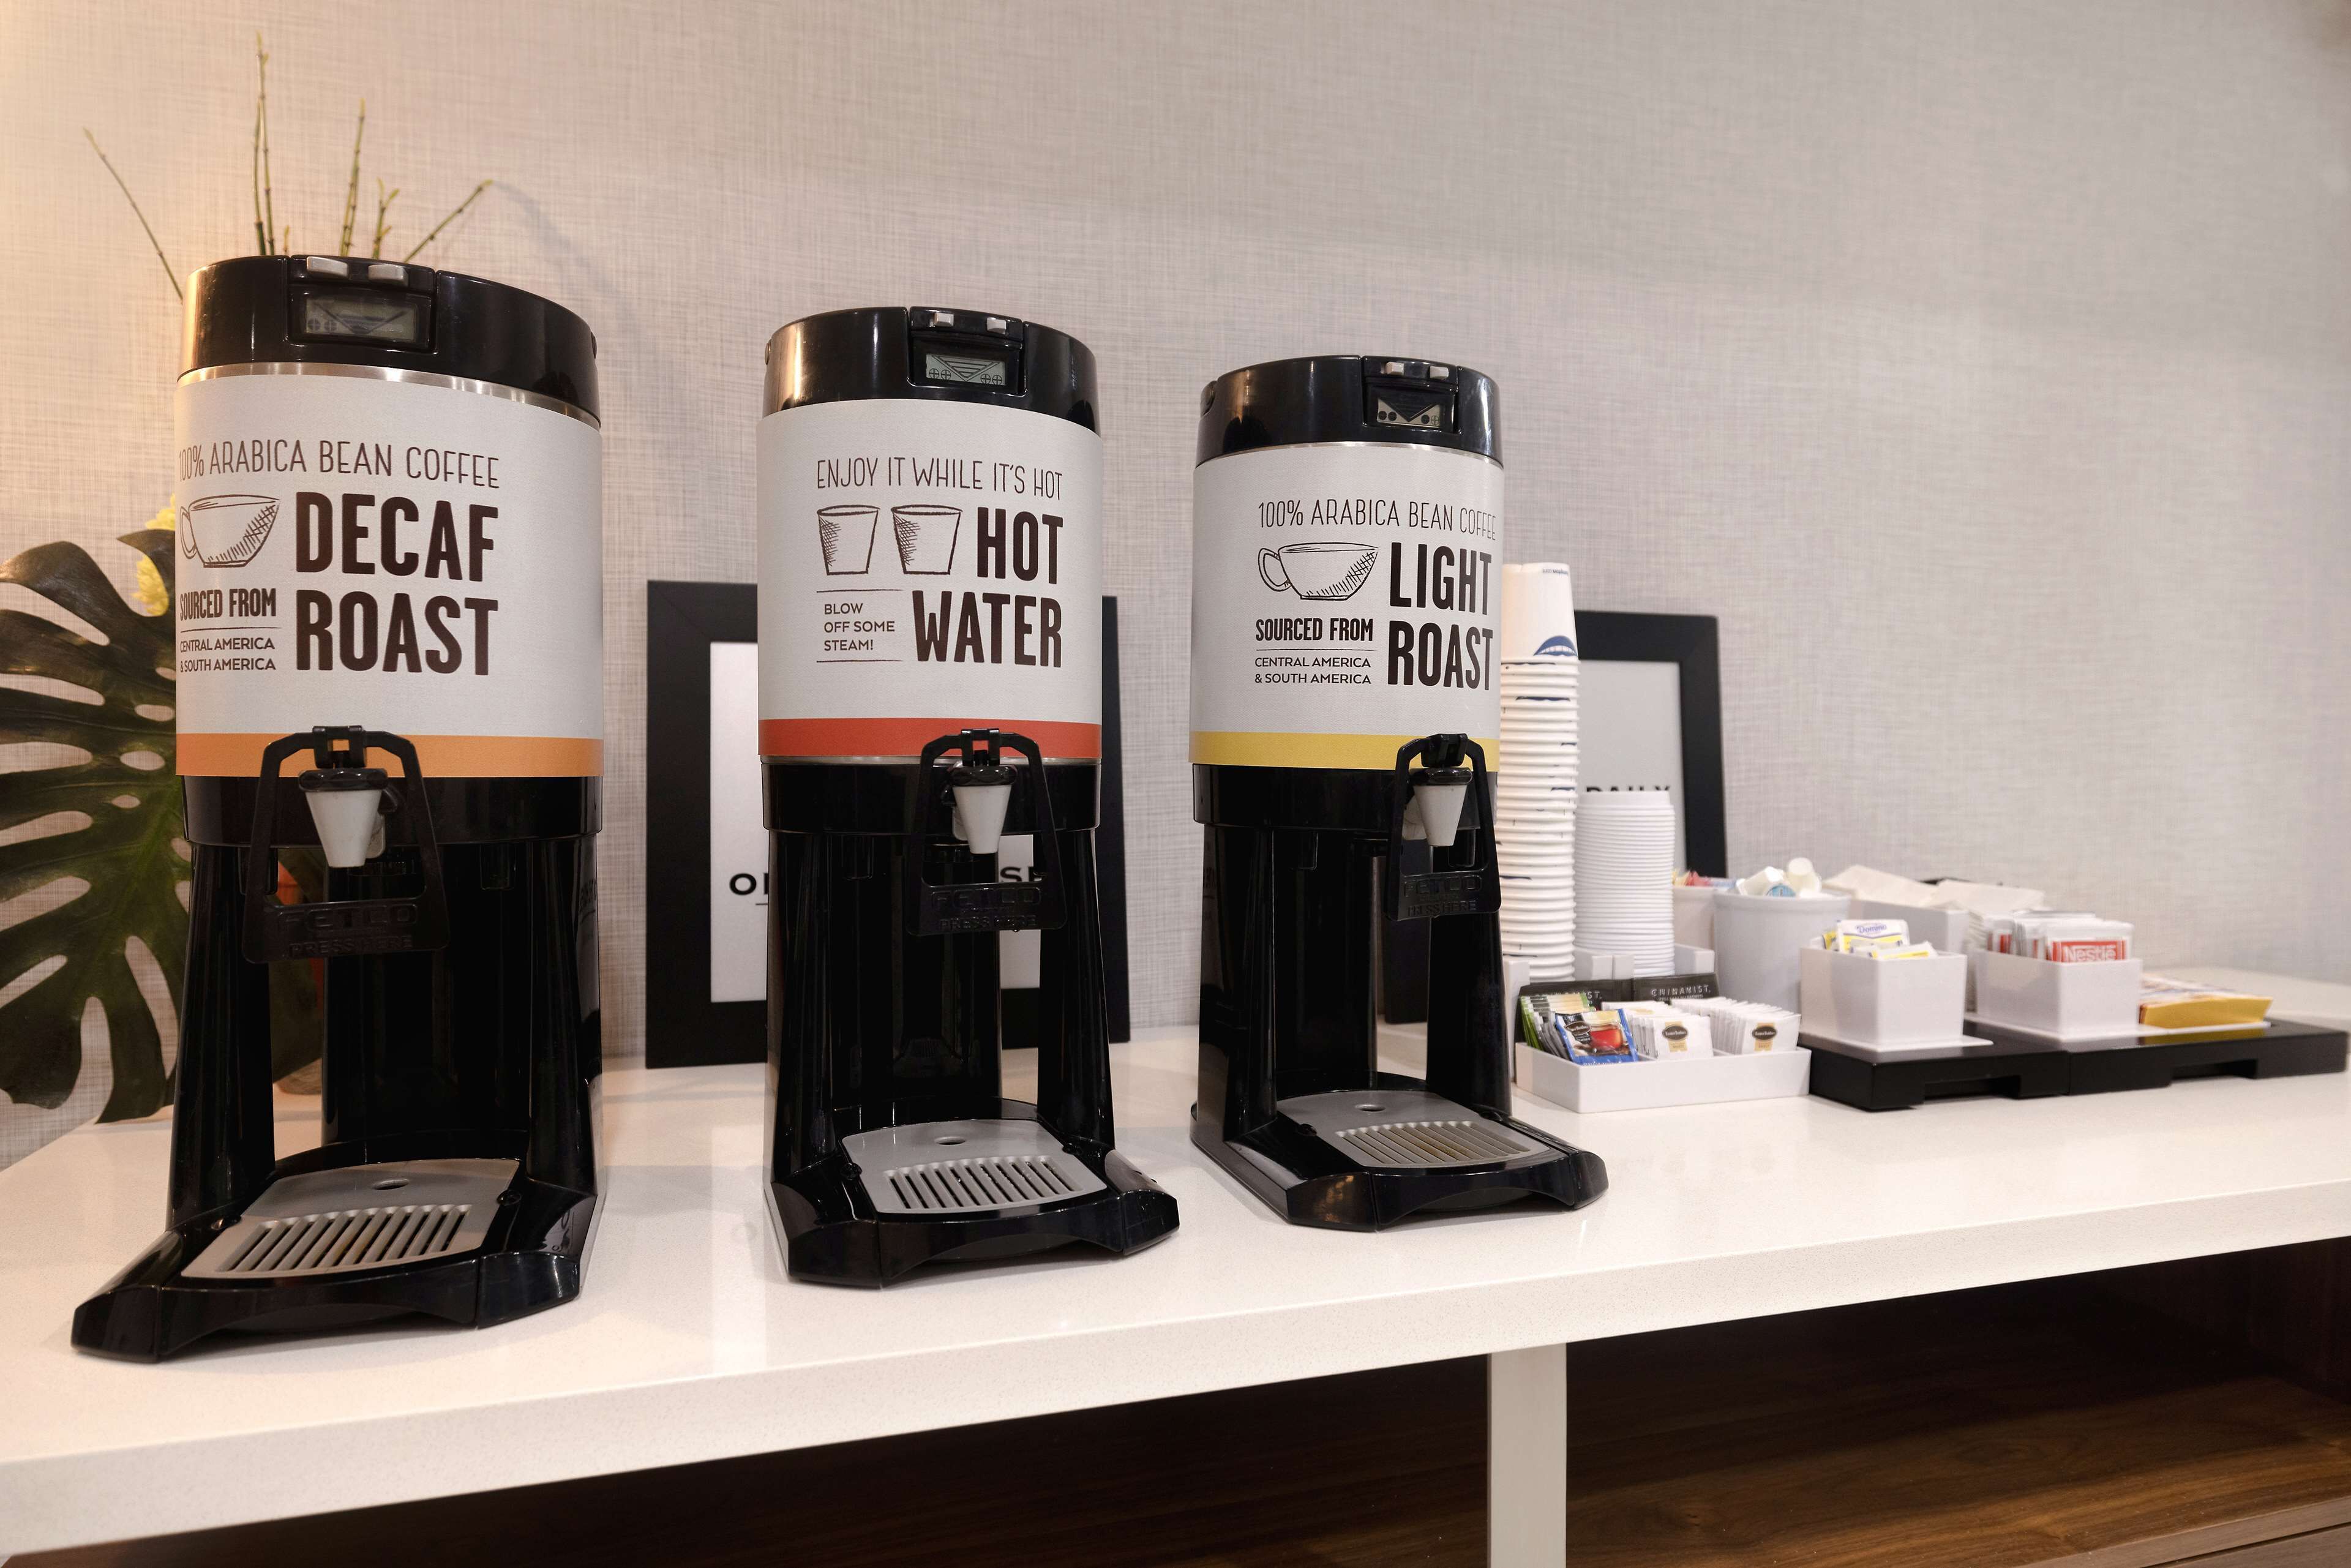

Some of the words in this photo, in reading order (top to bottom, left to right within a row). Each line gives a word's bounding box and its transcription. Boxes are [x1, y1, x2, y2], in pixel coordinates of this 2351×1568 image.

[179, 445, 204, 481] 100%
[210, 440, 307, 475] ARABICA
[320, 440, 391, 476] BEAN
[407, 447, 500, 489] COFFEE
[817, 457, 878, 489] ENJOY
[888, 457, 906, 486] IT
[912, 457, 983, 489] WHILE
[994, 463, 1025, 493] IT'S
[1034, 468, 1062, 500] HOT
[1259, 500, 1303, 528] 100%
[1311, 499, 1400, 526] ARABICA
[1409, 501, 1452, 531] BEAN
[1460, 508, 1496, 541] COFFEE
[296, 492, 498, 582] DECAF
[977, 507, 1063, 584] HOT
[1390, 542, 1491, 615] LIGHT
[180, 590, 223, 621] SOURCED
[229, 588, 276, 617] FROM
[825, 603, 863, 615] BLOW
[296, 590, 498, 675] ROAST
[824, 621, 850, 633] OFF
[853, 621, 895, 632] SOME
[912, 590, 1061, 667] WATER
[1256, 618, 1322, 641] SOURCED
[1330, 618, 1373, 641] FROM
[181, 639, 212, 653] CENTRAL
[214, 637, 275, 650] AMERICA
[824, 639, 873, 651] STEAM!
[1388, 620, 1493, 690] ROAST
[181, 661, 184, 672] &
[184, 659, 211, 672] SOUTH
[214, 658, 276, 670] AMERICA
[1254, 673, 1262, 683] &
[1265, 673, 1307, 683] SOUTH
[1310, 674, 1371, 684] AMERICA
[1255, 657, 1310, 667] CENTRAL
[1311, 658, 1371, 667] AMERICA
[289, 939, 354, 957] PRESS
